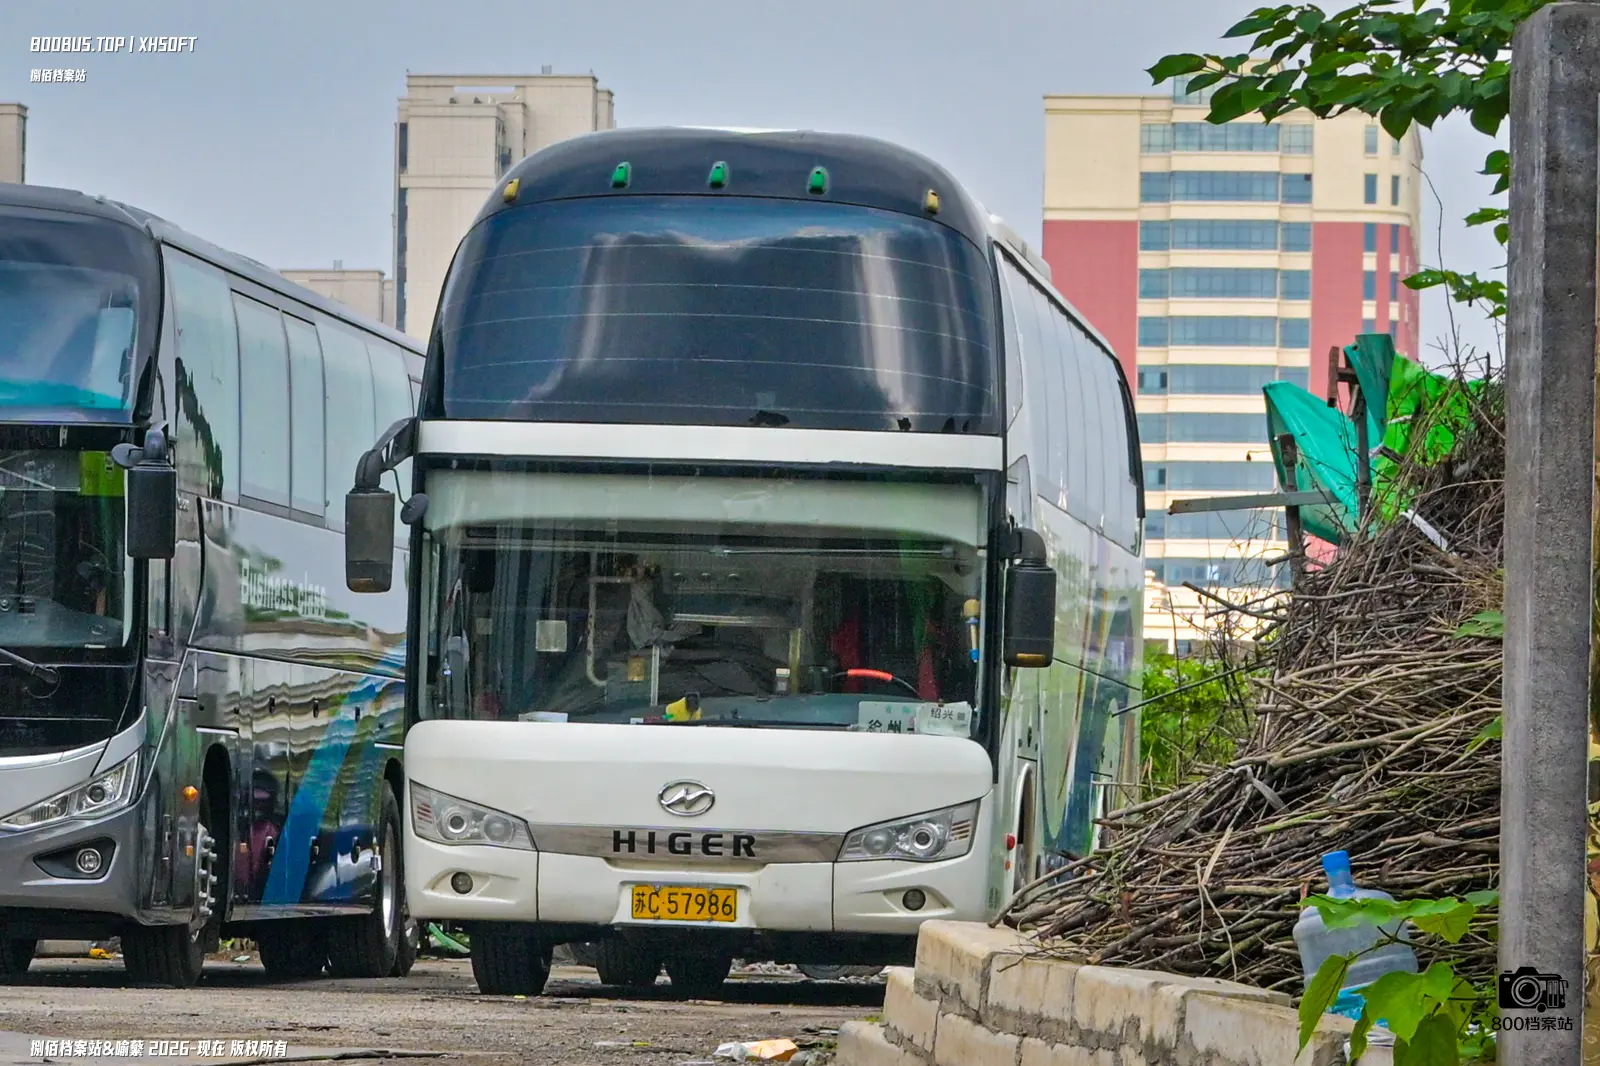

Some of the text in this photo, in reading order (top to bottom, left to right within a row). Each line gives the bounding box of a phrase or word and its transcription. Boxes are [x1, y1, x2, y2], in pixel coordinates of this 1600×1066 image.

[241, 558, 298, 613] Business
[930, 707, 954, 720] 绍兴
[612, 830, 756, 858] HIGER
